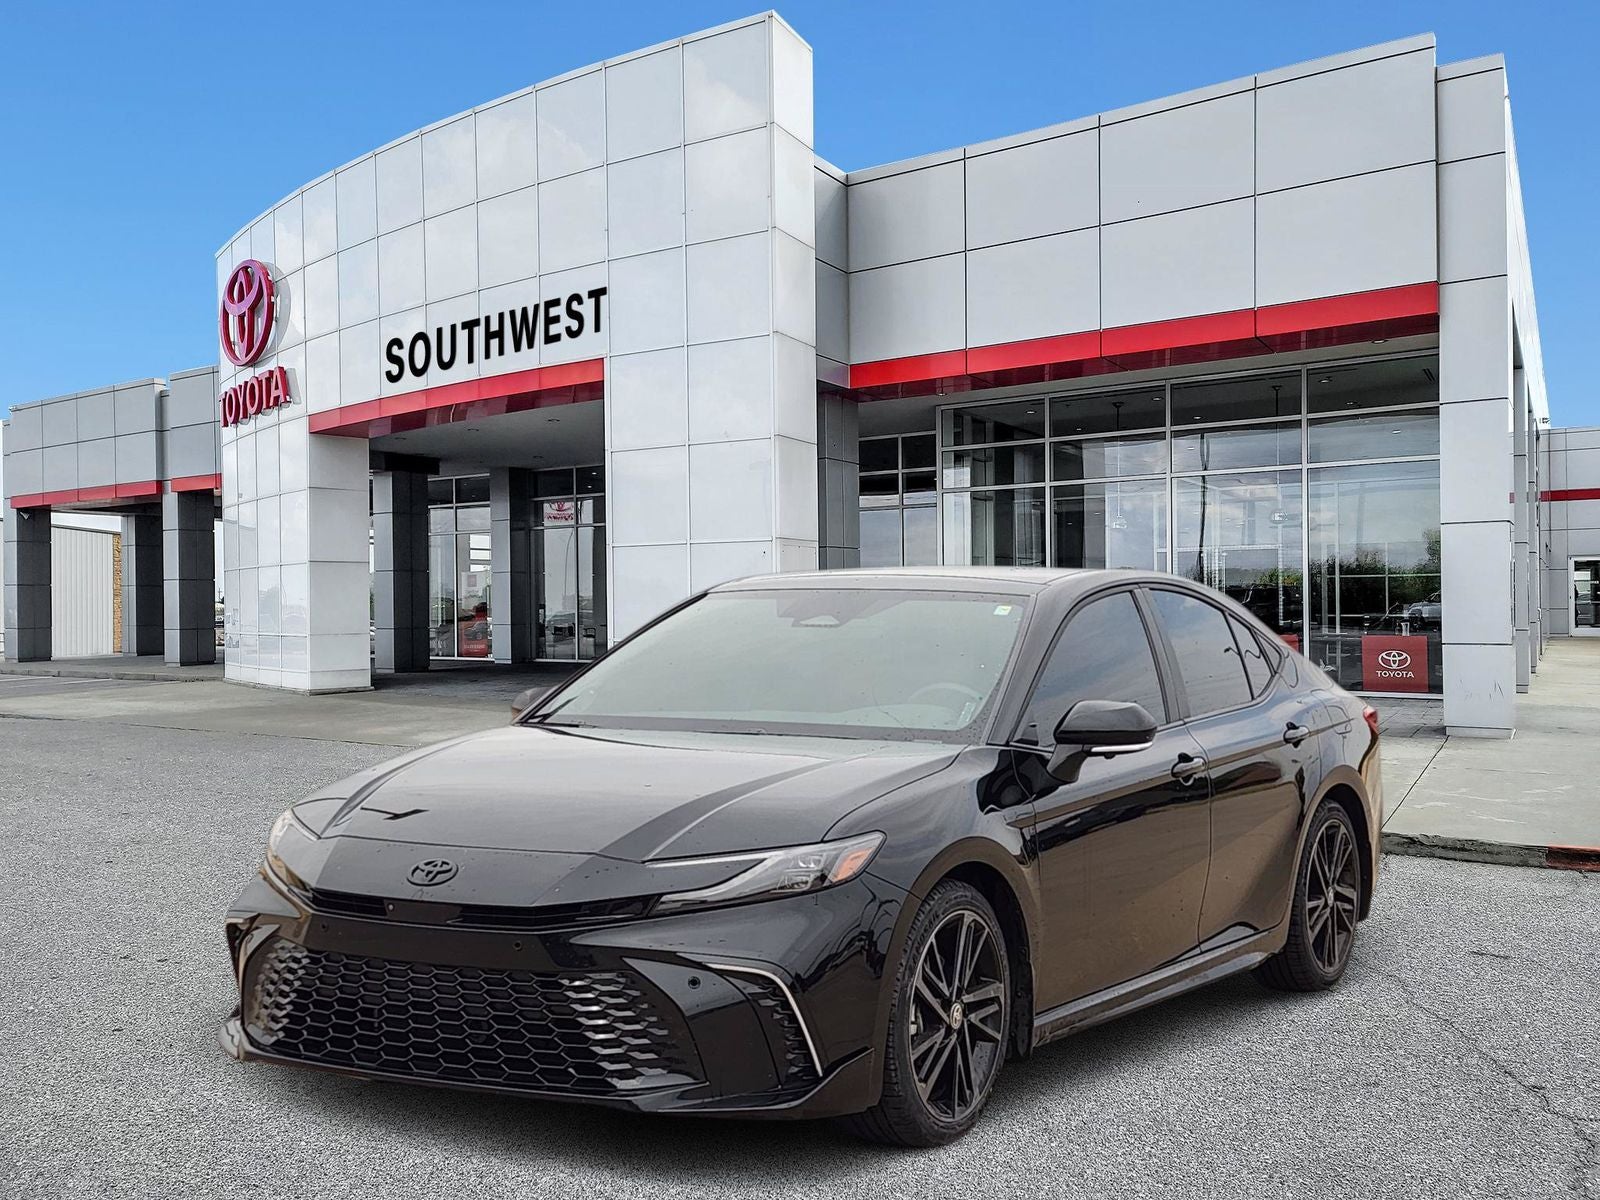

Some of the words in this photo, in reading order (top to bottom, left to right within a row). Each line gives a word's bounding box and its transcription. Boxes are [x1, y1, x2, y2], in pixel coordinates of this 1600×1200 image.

[385, 286, 607, 383] SOUTHWEST
[219, 366, 291, 427] TOYOTA
[1376, 670, 1414, 678] TOYOTA
